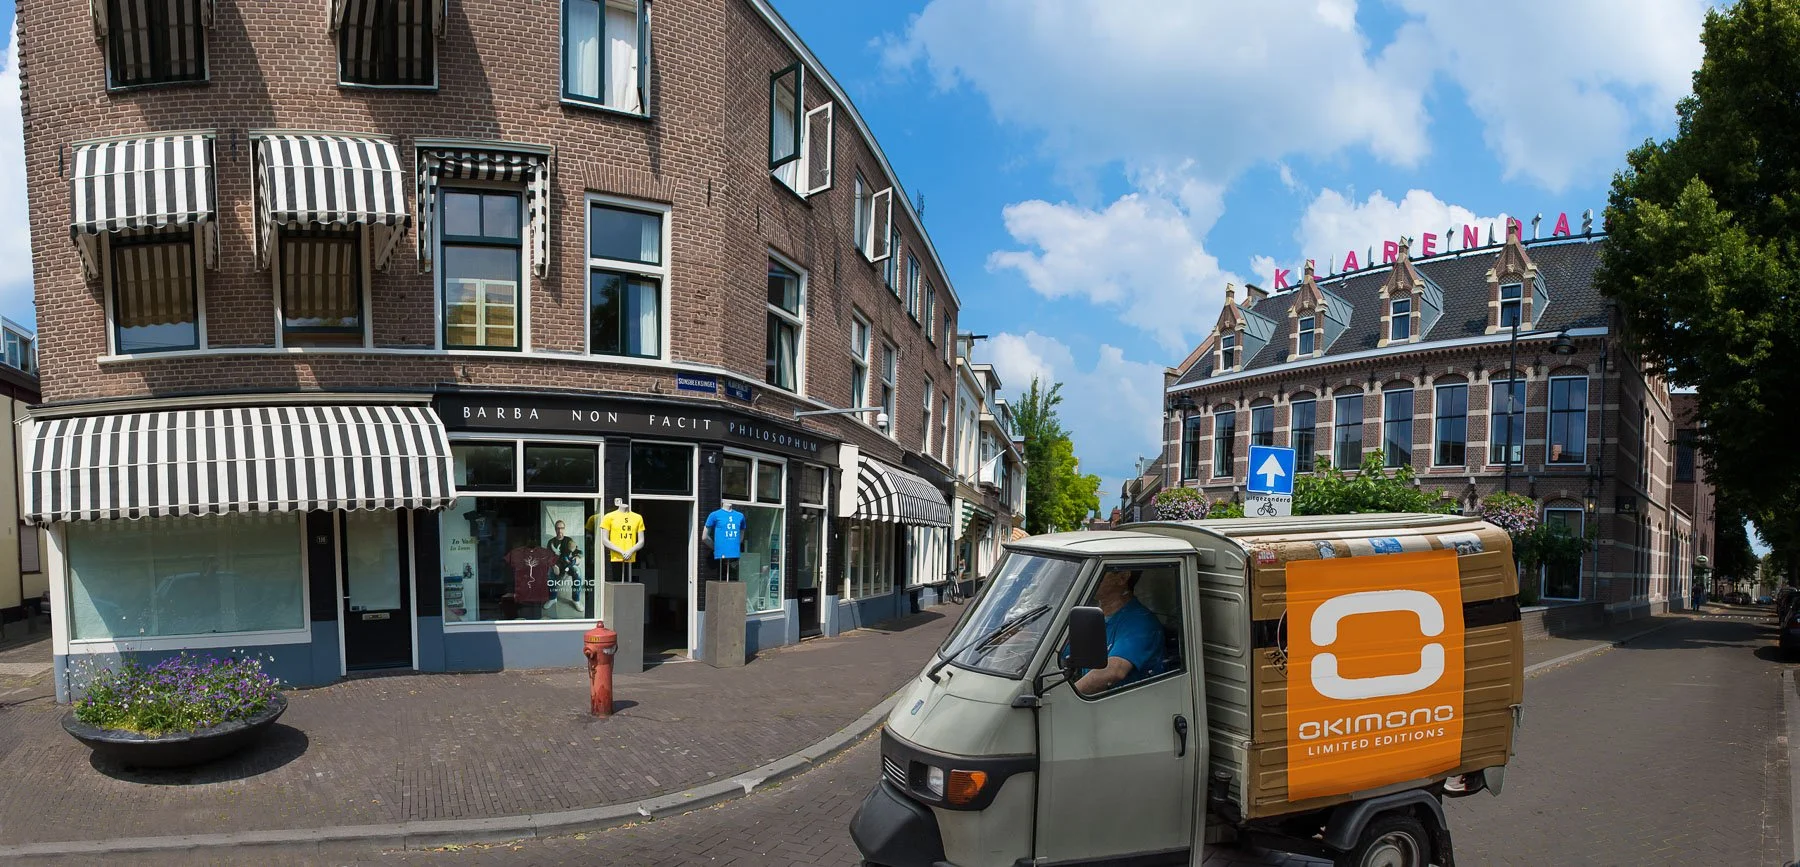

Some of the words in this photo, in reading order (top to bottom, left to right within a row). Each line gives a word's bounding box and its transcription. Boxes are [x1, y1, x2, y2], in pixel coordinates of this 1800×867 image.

[678, 378, 715, 388] SONSBEEKSINGEL
[463, 407, 539, 420] BARBA
[572, 410, 618, 422] NON
[649, 415, 711, 430] FACIT
[730, 422, 817, 451] PHILOSOPHUM
[725, 530, 738, 538] IJT
[547, 579, 595, 587] OKIMONO
[1299, 705, 1453, 740] OKIMONO
[1308, 737, 1370, 756] LIMITED
[1375, 727, 1444, 747] EDITIONS
